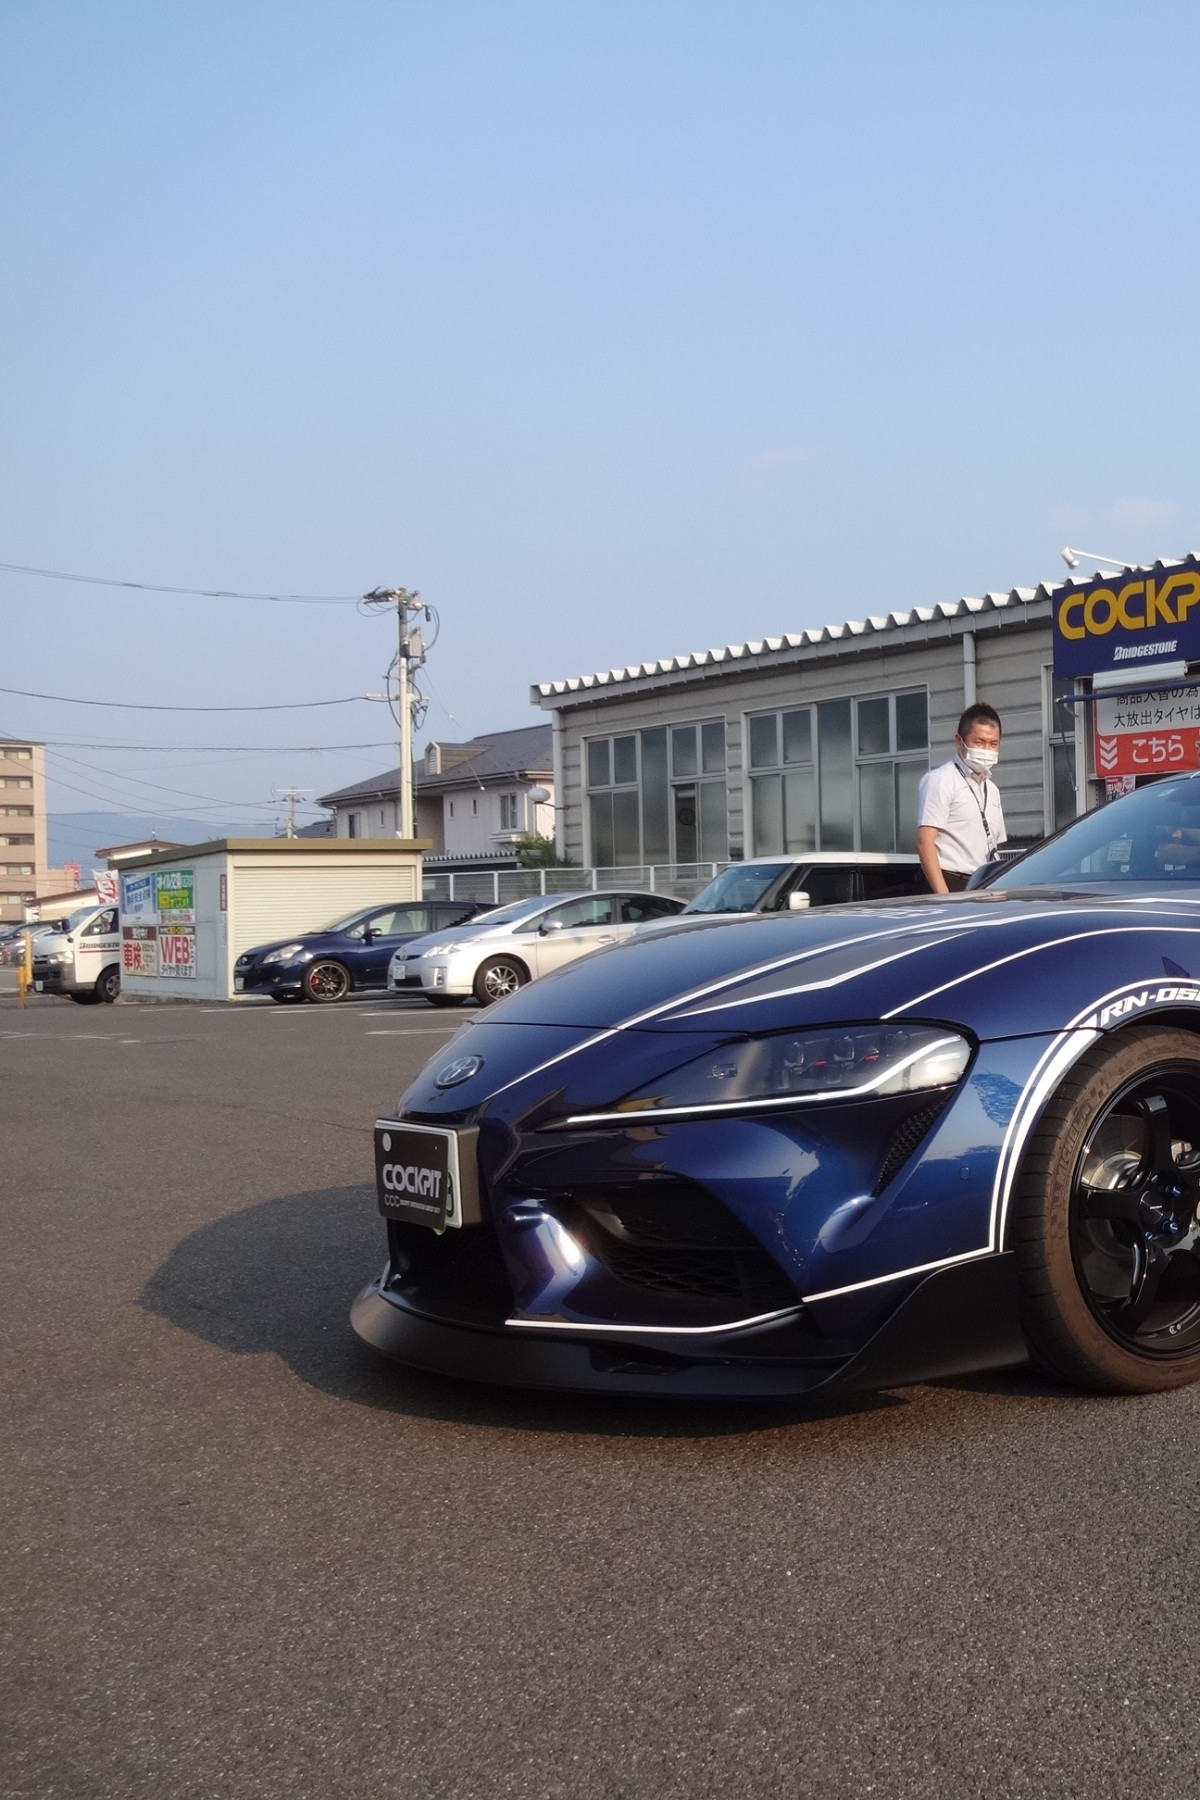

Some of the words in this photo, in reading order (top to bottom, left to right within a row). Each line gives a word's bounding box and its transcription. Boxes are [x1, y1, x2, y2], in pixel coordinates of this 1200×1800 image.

[1113, 640, 1178, 661] BRIDGESTONE
[1132, 735, 1185, 764] こちら
[123, 942, 144, 971] 車検
[160, 936, 190, 964] WEB
[1060, 1102, 1092, 1181] MICHELIN
[382, 1163, 442, 1199] COCKPIT
